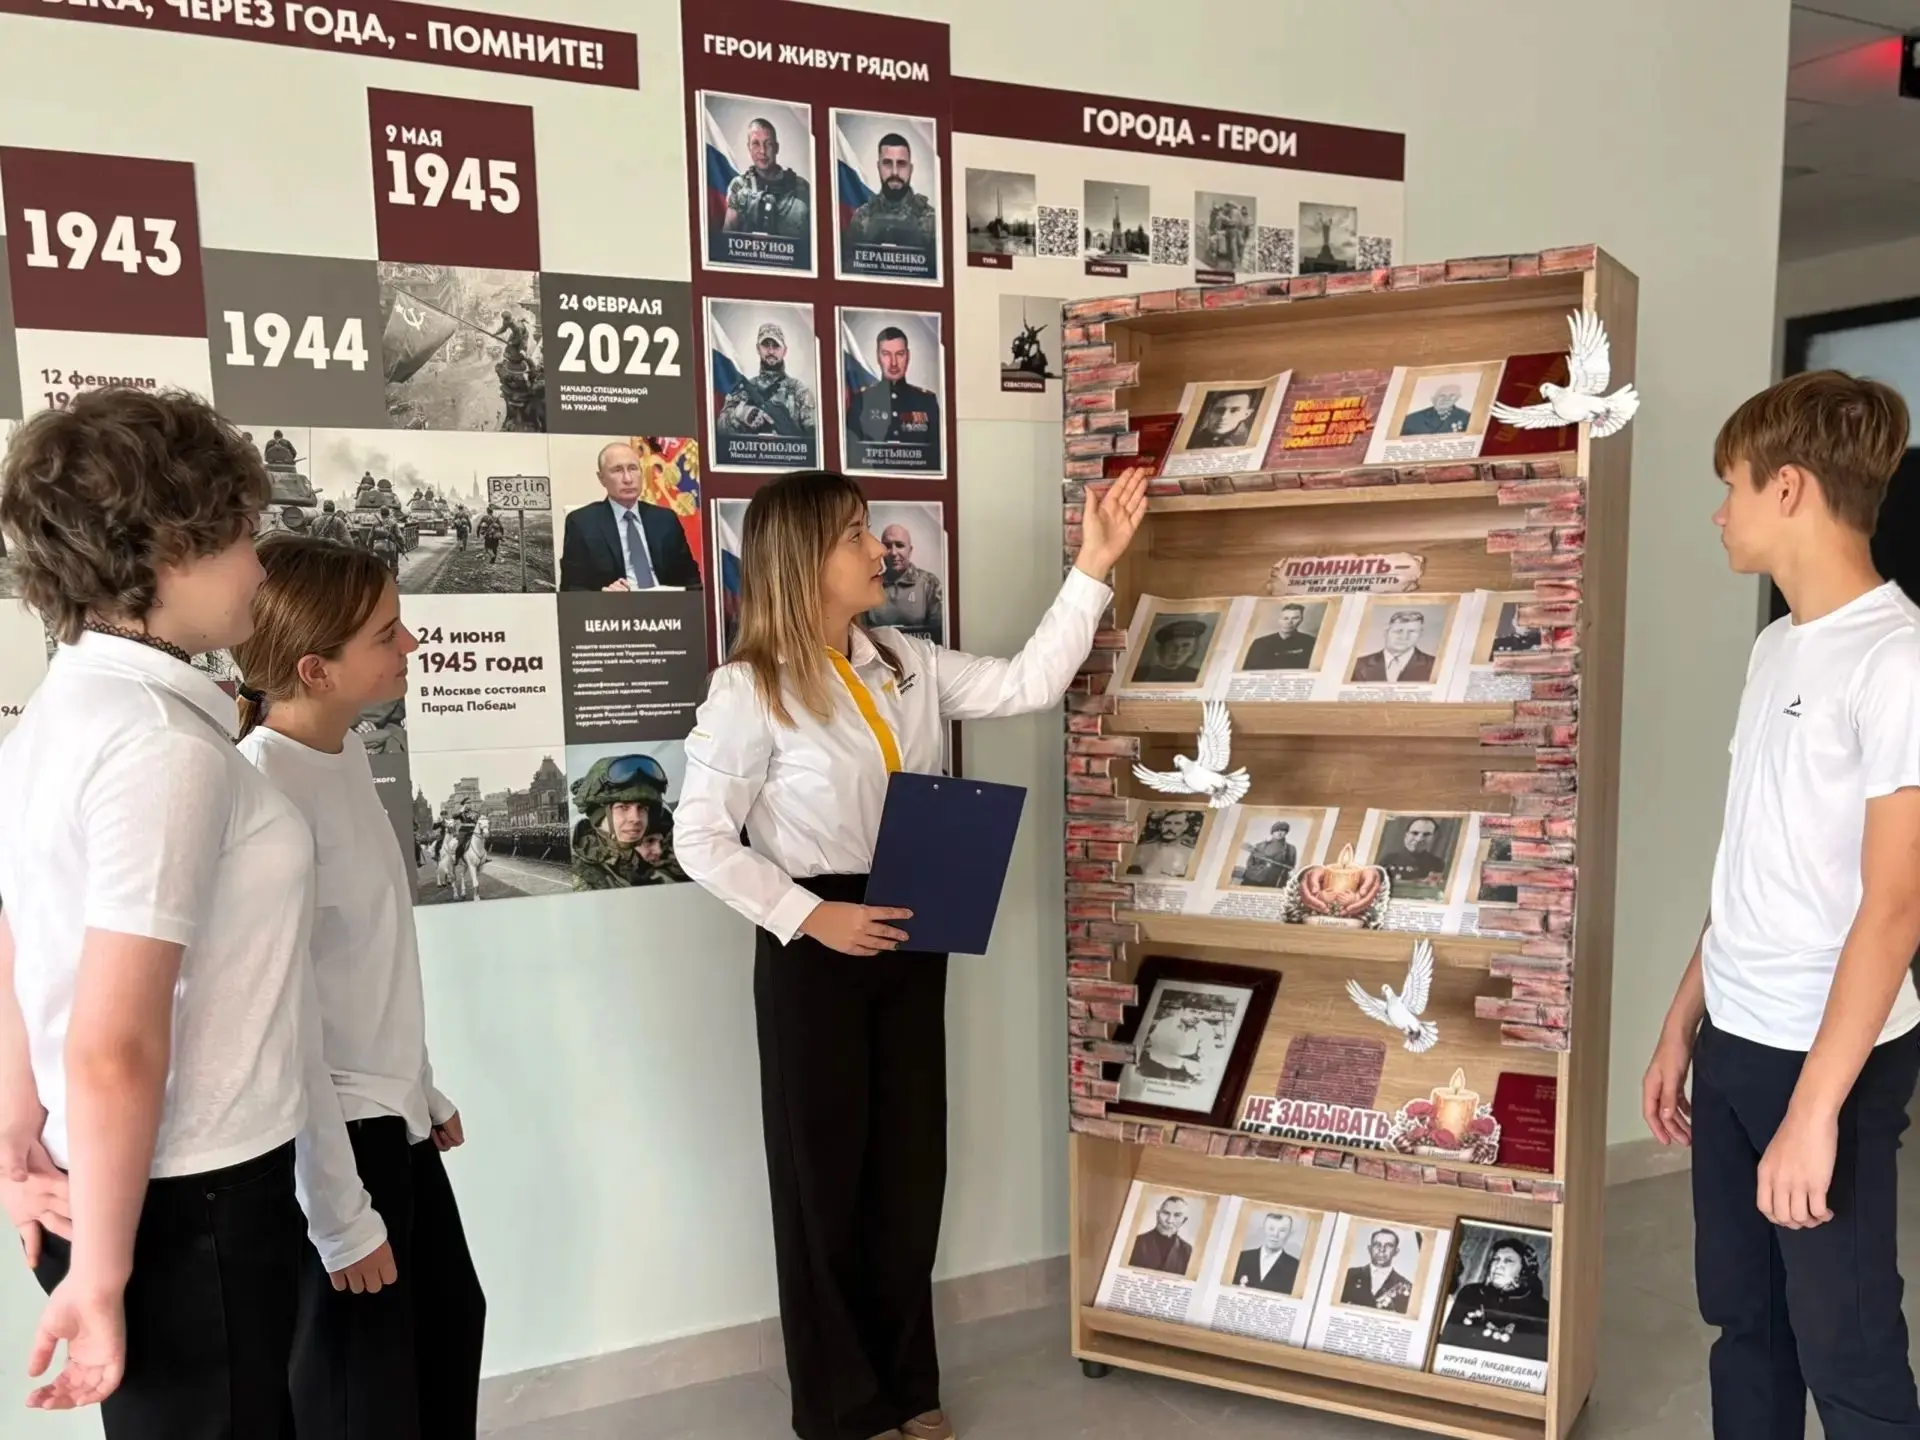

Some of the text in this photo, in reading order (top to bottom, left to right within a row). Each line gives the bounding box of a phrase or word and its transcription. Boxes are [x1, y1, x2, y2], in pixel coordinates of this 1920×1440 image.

[164, 0, 276, 28] ЧЕРЕЗ
[285, 2, 396, 50] ГОДА,
[428, 21, 604, 70] ПОМНИТЕ!
[703, 33, 930, 82] ГЕРОИ ЖИВУТ РЯДОМ
[385, 124, 443, 148] 9 МАЯ
[1082, 106, 1196, 148] ГОРОДА
[1217, 123, 1297, 157] ГЕРОИ
[386, 149, 521, 214] 1945
[23, 208, 182, 276] 1943
[728, 238, 795, 254] ГОРБУНОВ
[855, 250, 926, 265] ГЕРАЩЕНКО
[559, 293, 662, 315] 24 ФЕВРАЛЯ
[223, 310, 369, 371] 1944
[557, 321, 681, 377] 2022
[41, 369, 63, 385] 12
[560, 385, 648, 396] НАЧАЛО СПЕЦИАЛЬНОЙ
[561, 394, 639, 405] ВОЕННОЙ ОПЕРАЦИИ
[574, 404, 608, 412] УКРАИНЕ
[729, 440, 808, 453] ДОЛГОПОЛОВ
[865, 448, 923, 459] ТРЕТЬЯКОВ
[492, 480, 545, 492] Berlin
[503, 495, 538, 506] 20 km
[1285, 559, 1391, 577] ПОМНИТЬ
[1288, 576, 1400, 587] ЗНАЧИТ НЕ ДОПУСТИТЬ
[585, 619, 681, 632] ЦЕЛИ И ЗАДАЧИ
[418, 627, 506, 645] 24 июня
[418, 652, 543, 673] 1945 года
[421, 685, 546, 696] В Москве состоялся
[422, 700, 516, 715] Парад Победы
[1245, 1098, 1275, 1123] НЕ
[1444, 1354, 1542, 1379] КРУТИЙ (МЕДВЕДЕВА)
[1441, 1367, 1531, 1389] НИНА ДМИТРИЕВНА
